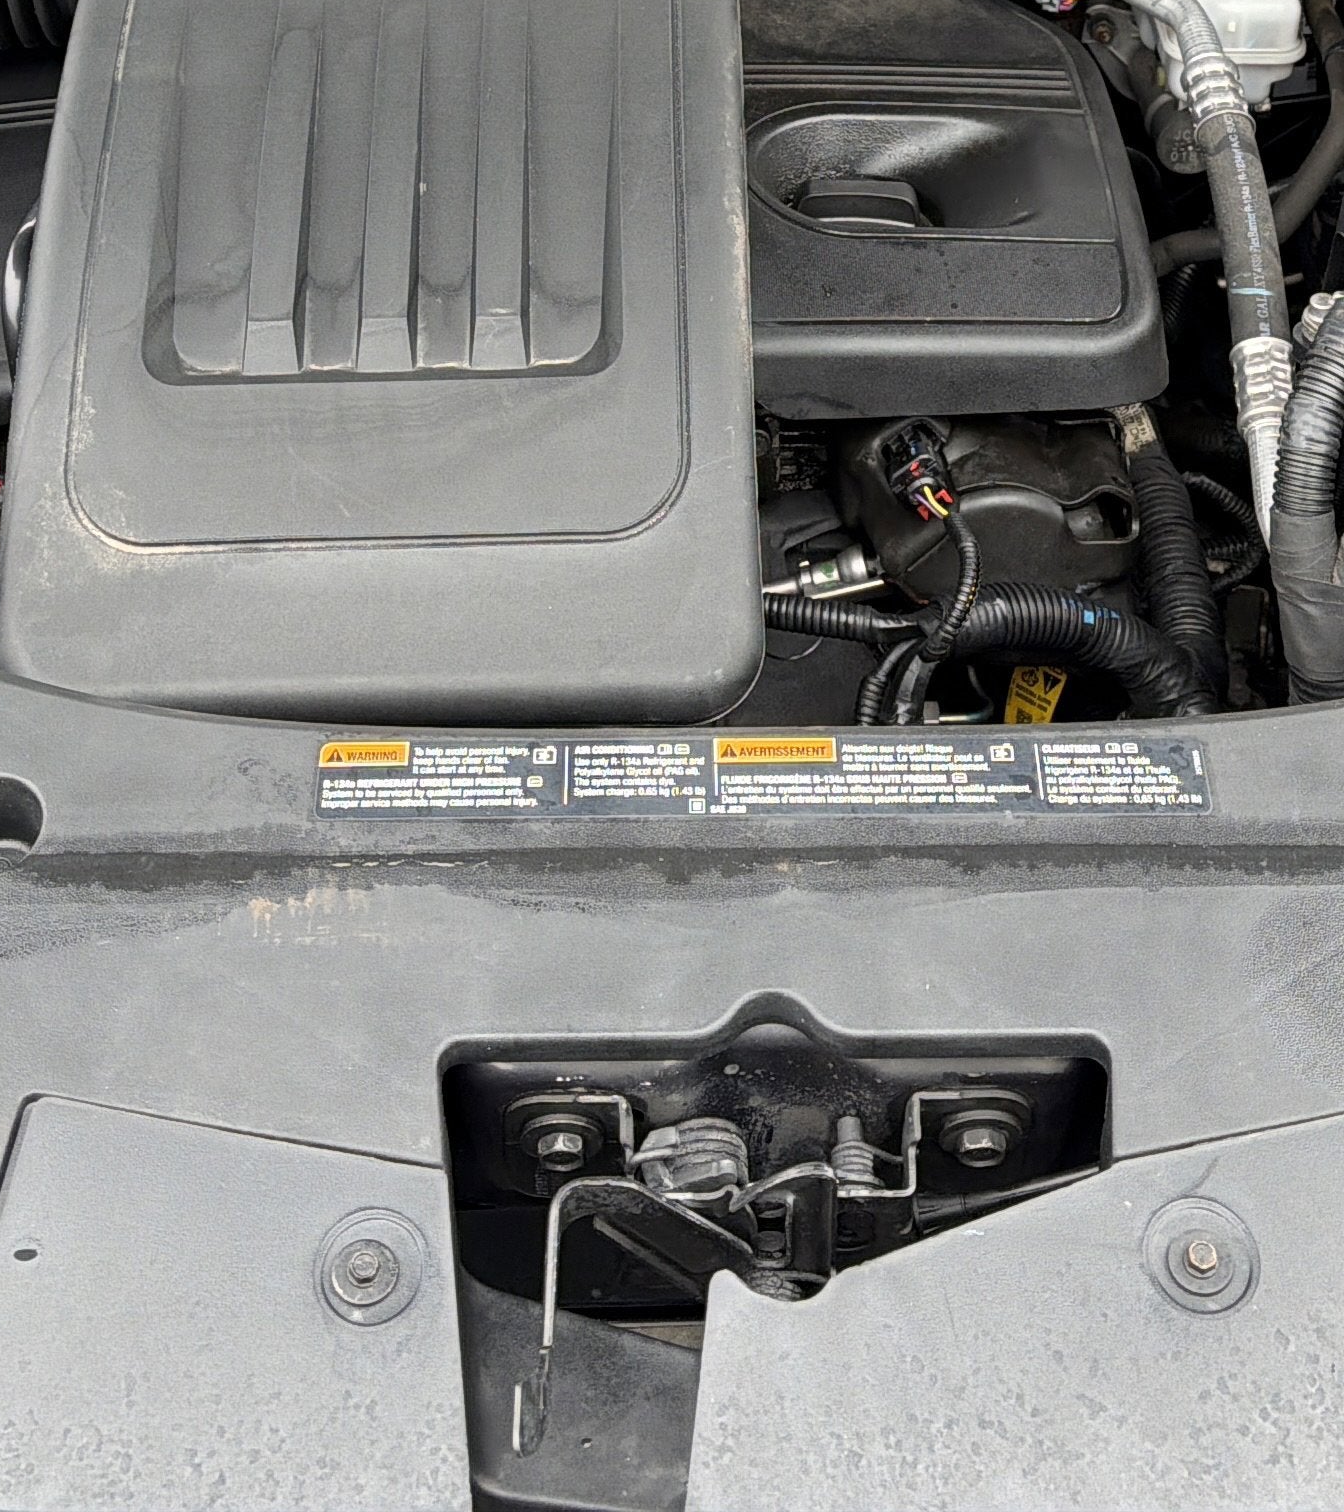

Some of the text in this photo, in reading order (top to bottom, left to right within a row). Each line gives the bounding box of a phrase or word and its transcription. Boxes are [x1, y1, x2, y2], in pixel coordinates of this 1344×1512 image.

[346, 751, 398, 761] WARNING
[739, 746, 826, 757] AVERTISSEMENT
[610, 757, 642, 766] R-134a
[1090, 766, 1122, 774] R-134a
[574, 788, 604, 798] System
